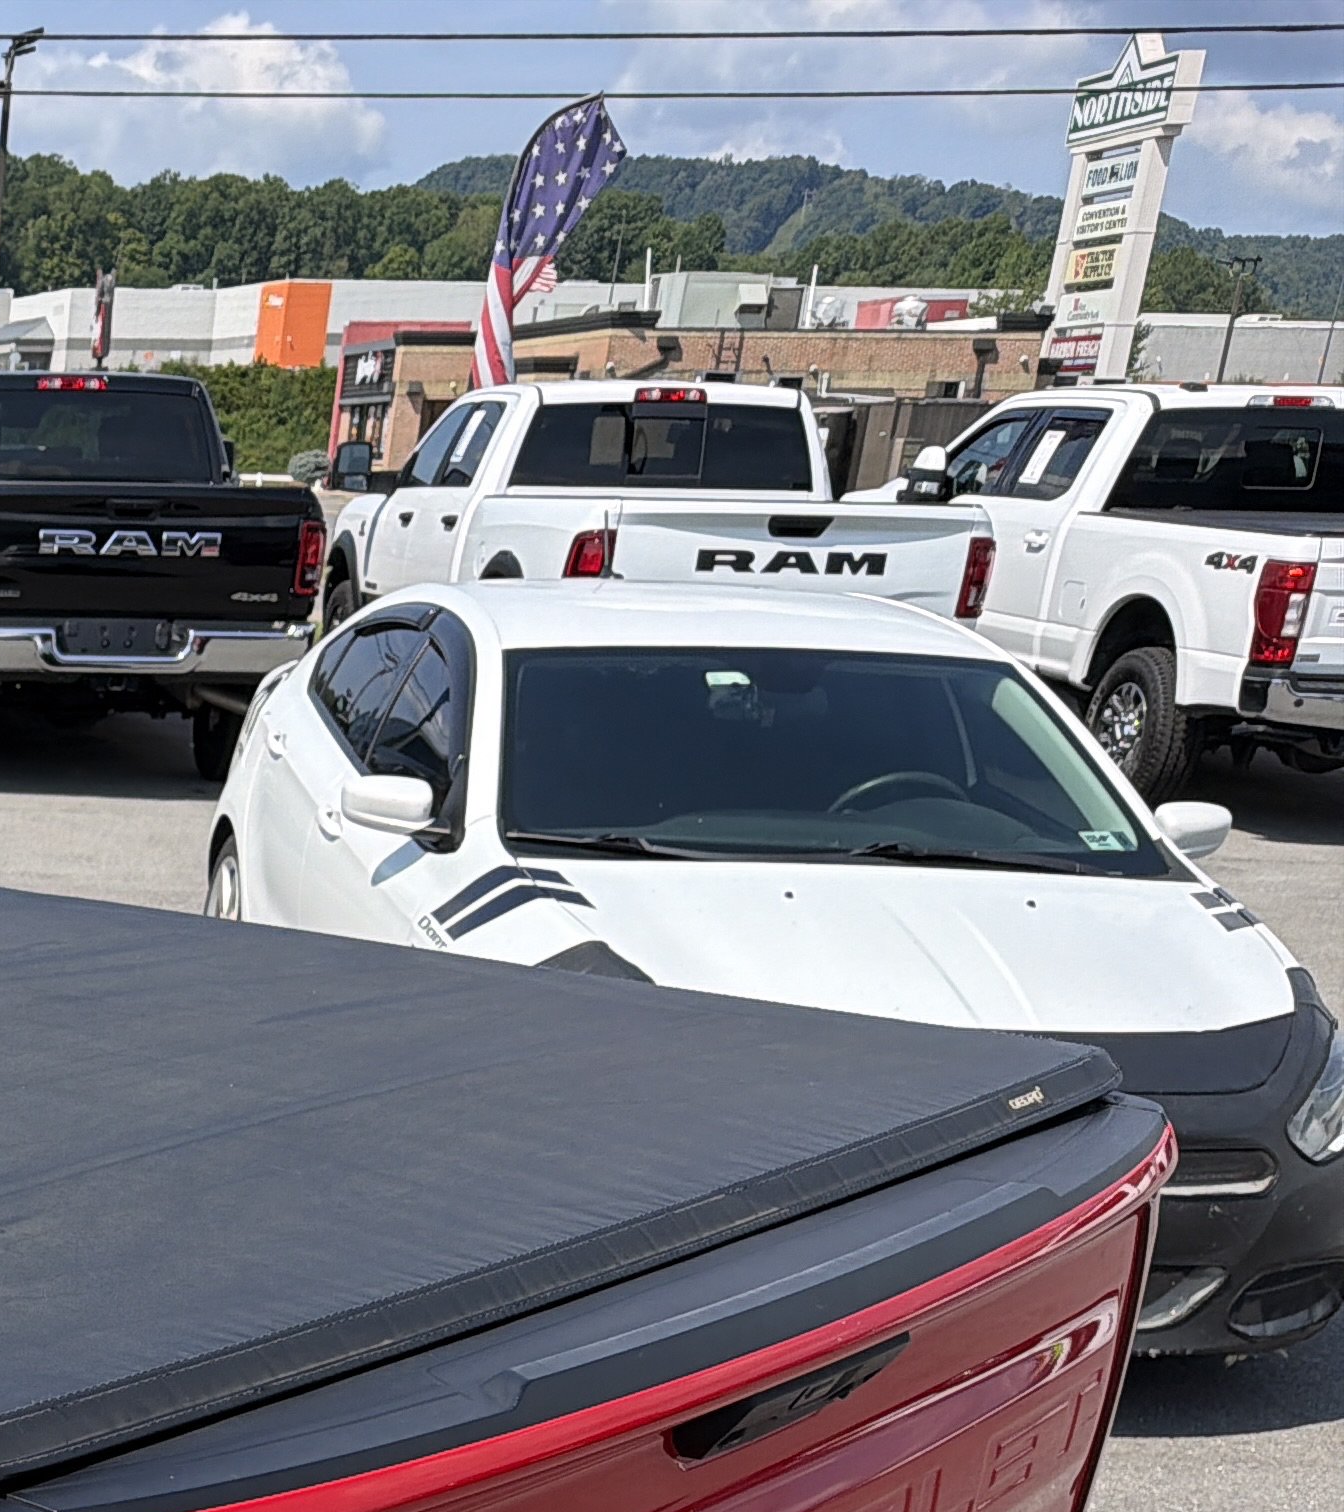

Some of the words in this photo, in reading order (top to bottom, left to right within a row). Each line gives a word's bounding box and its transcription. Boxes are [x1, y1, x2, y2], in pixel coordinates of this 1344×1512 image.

[1070, 76, 1174, 130] NORTHSIDE
[1086, 165, 1109, 189] FOOD
[38, 529, 222, 557] RAM
[695, 549, 889, 576] RAM
